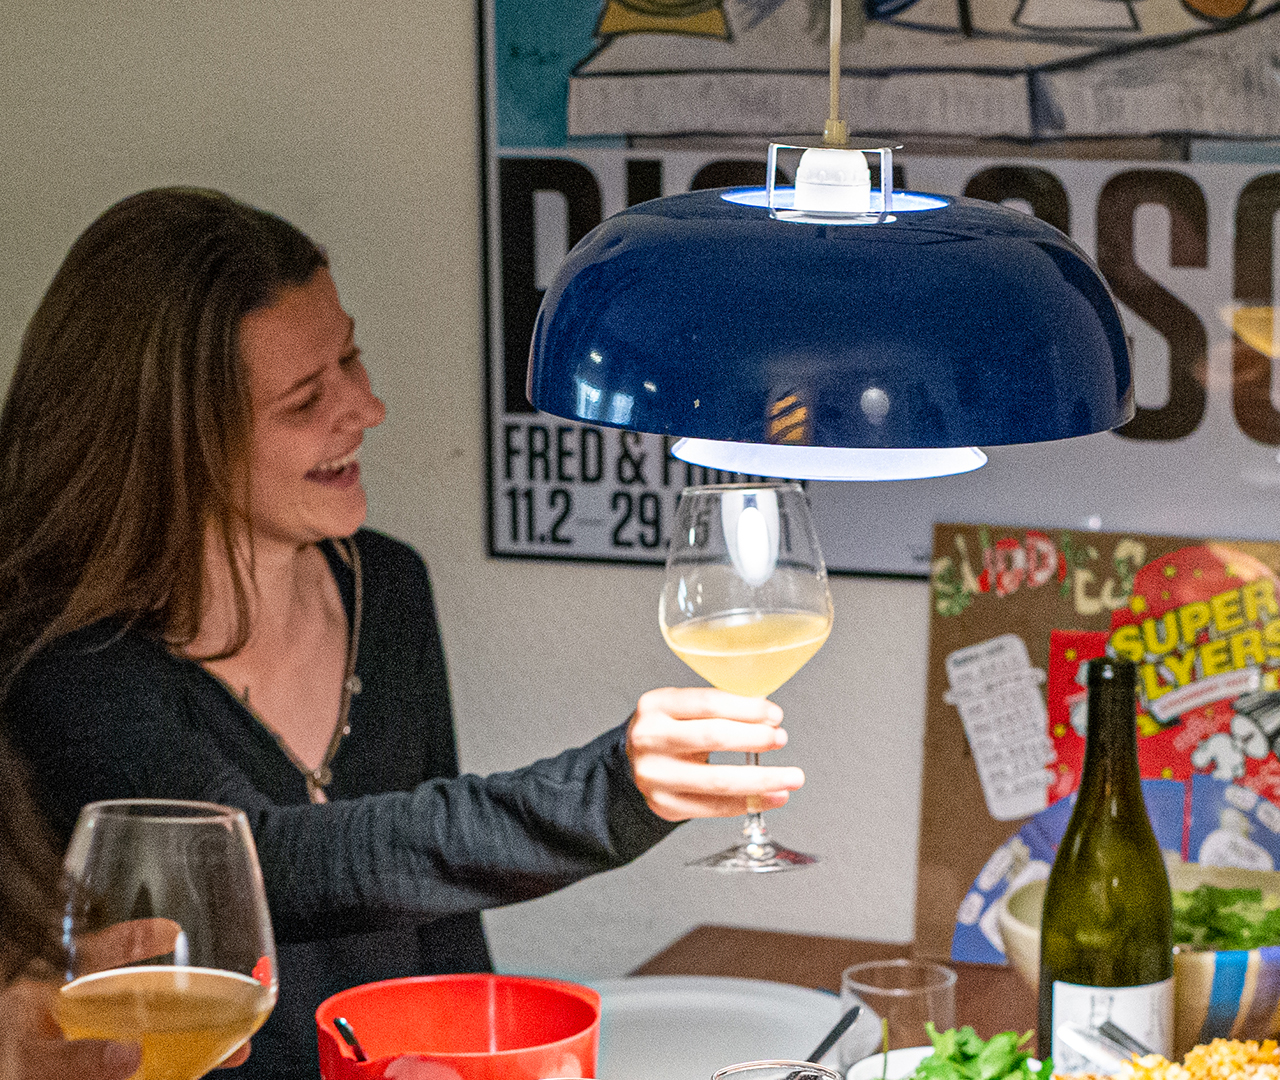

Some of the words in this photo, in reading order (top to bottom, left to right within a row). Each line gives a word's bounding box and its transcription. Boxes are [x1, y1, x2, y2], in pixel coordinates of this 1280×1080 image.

[505, 424, 603, 482] FRED
[618, 428, 646, 484] &
[1111, 580, 1279, 662] SUPER
